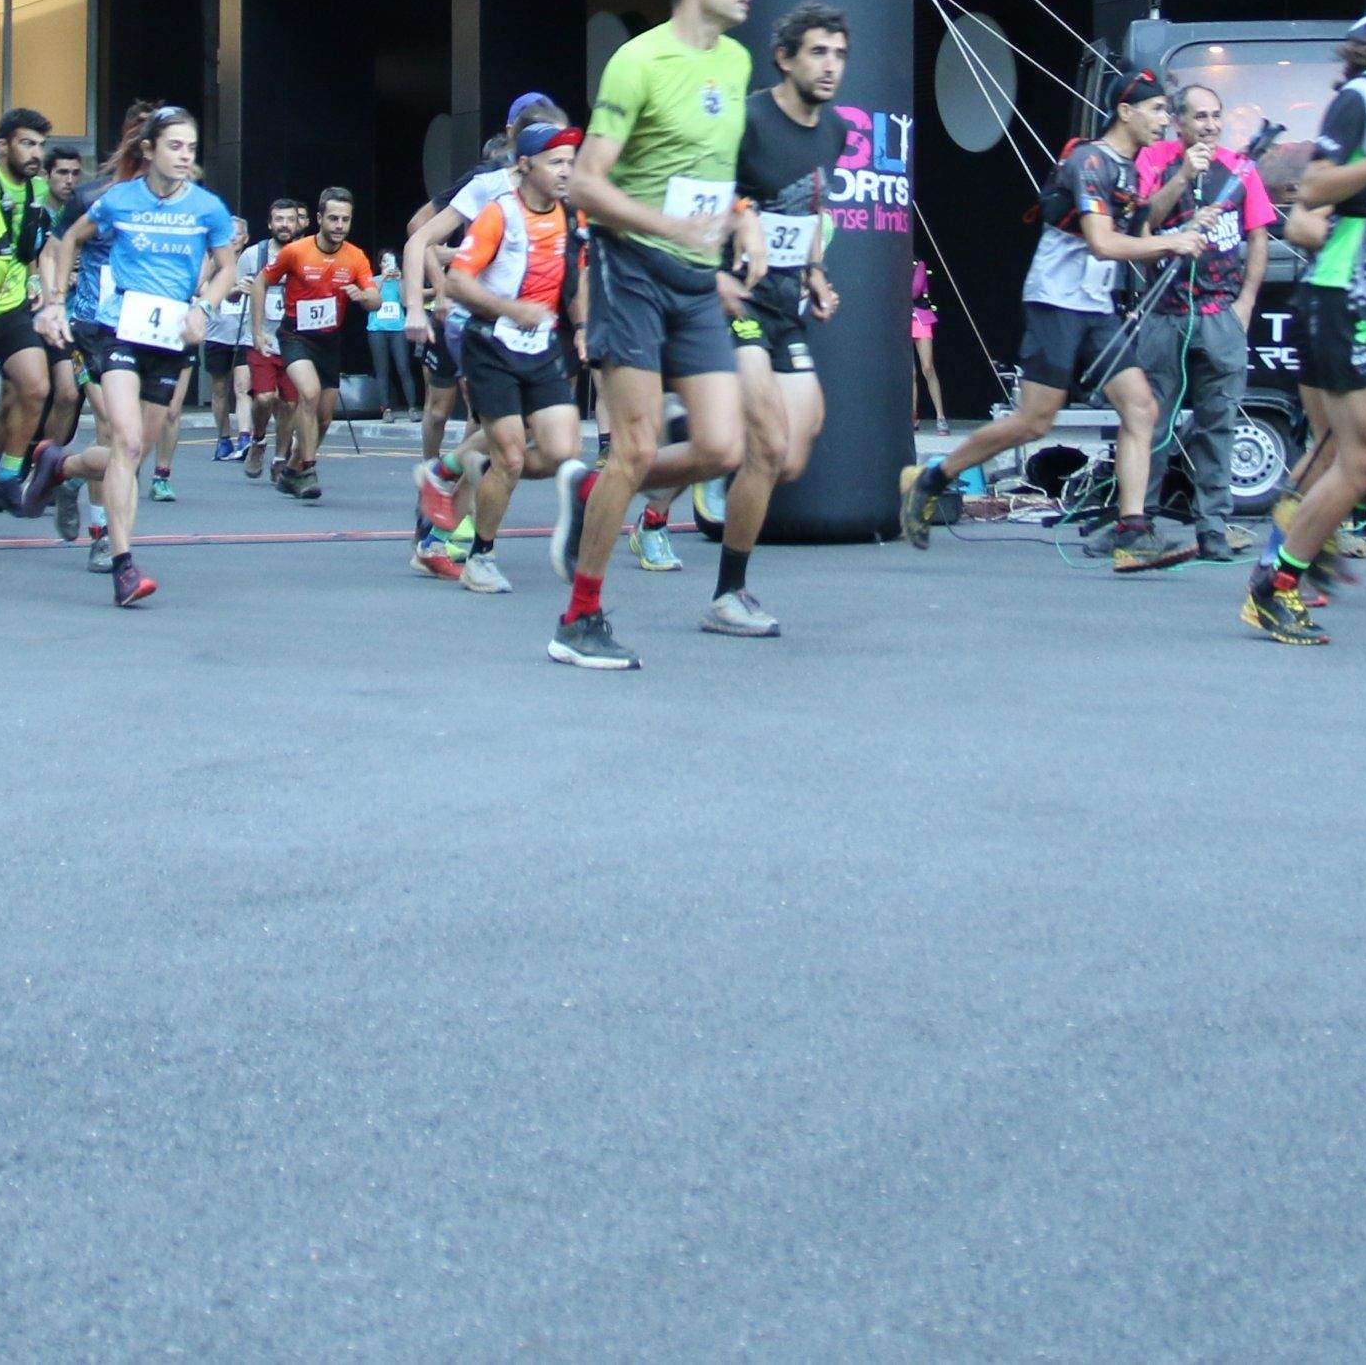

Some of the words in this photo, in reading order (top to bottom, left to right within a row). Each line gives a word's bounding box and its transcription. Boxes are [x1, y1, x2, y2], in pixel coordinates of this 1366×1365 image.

[772, 226, 800, 250] 32
[148, 307, 162, 329] 4
[310, 305, 325, 320] 57
